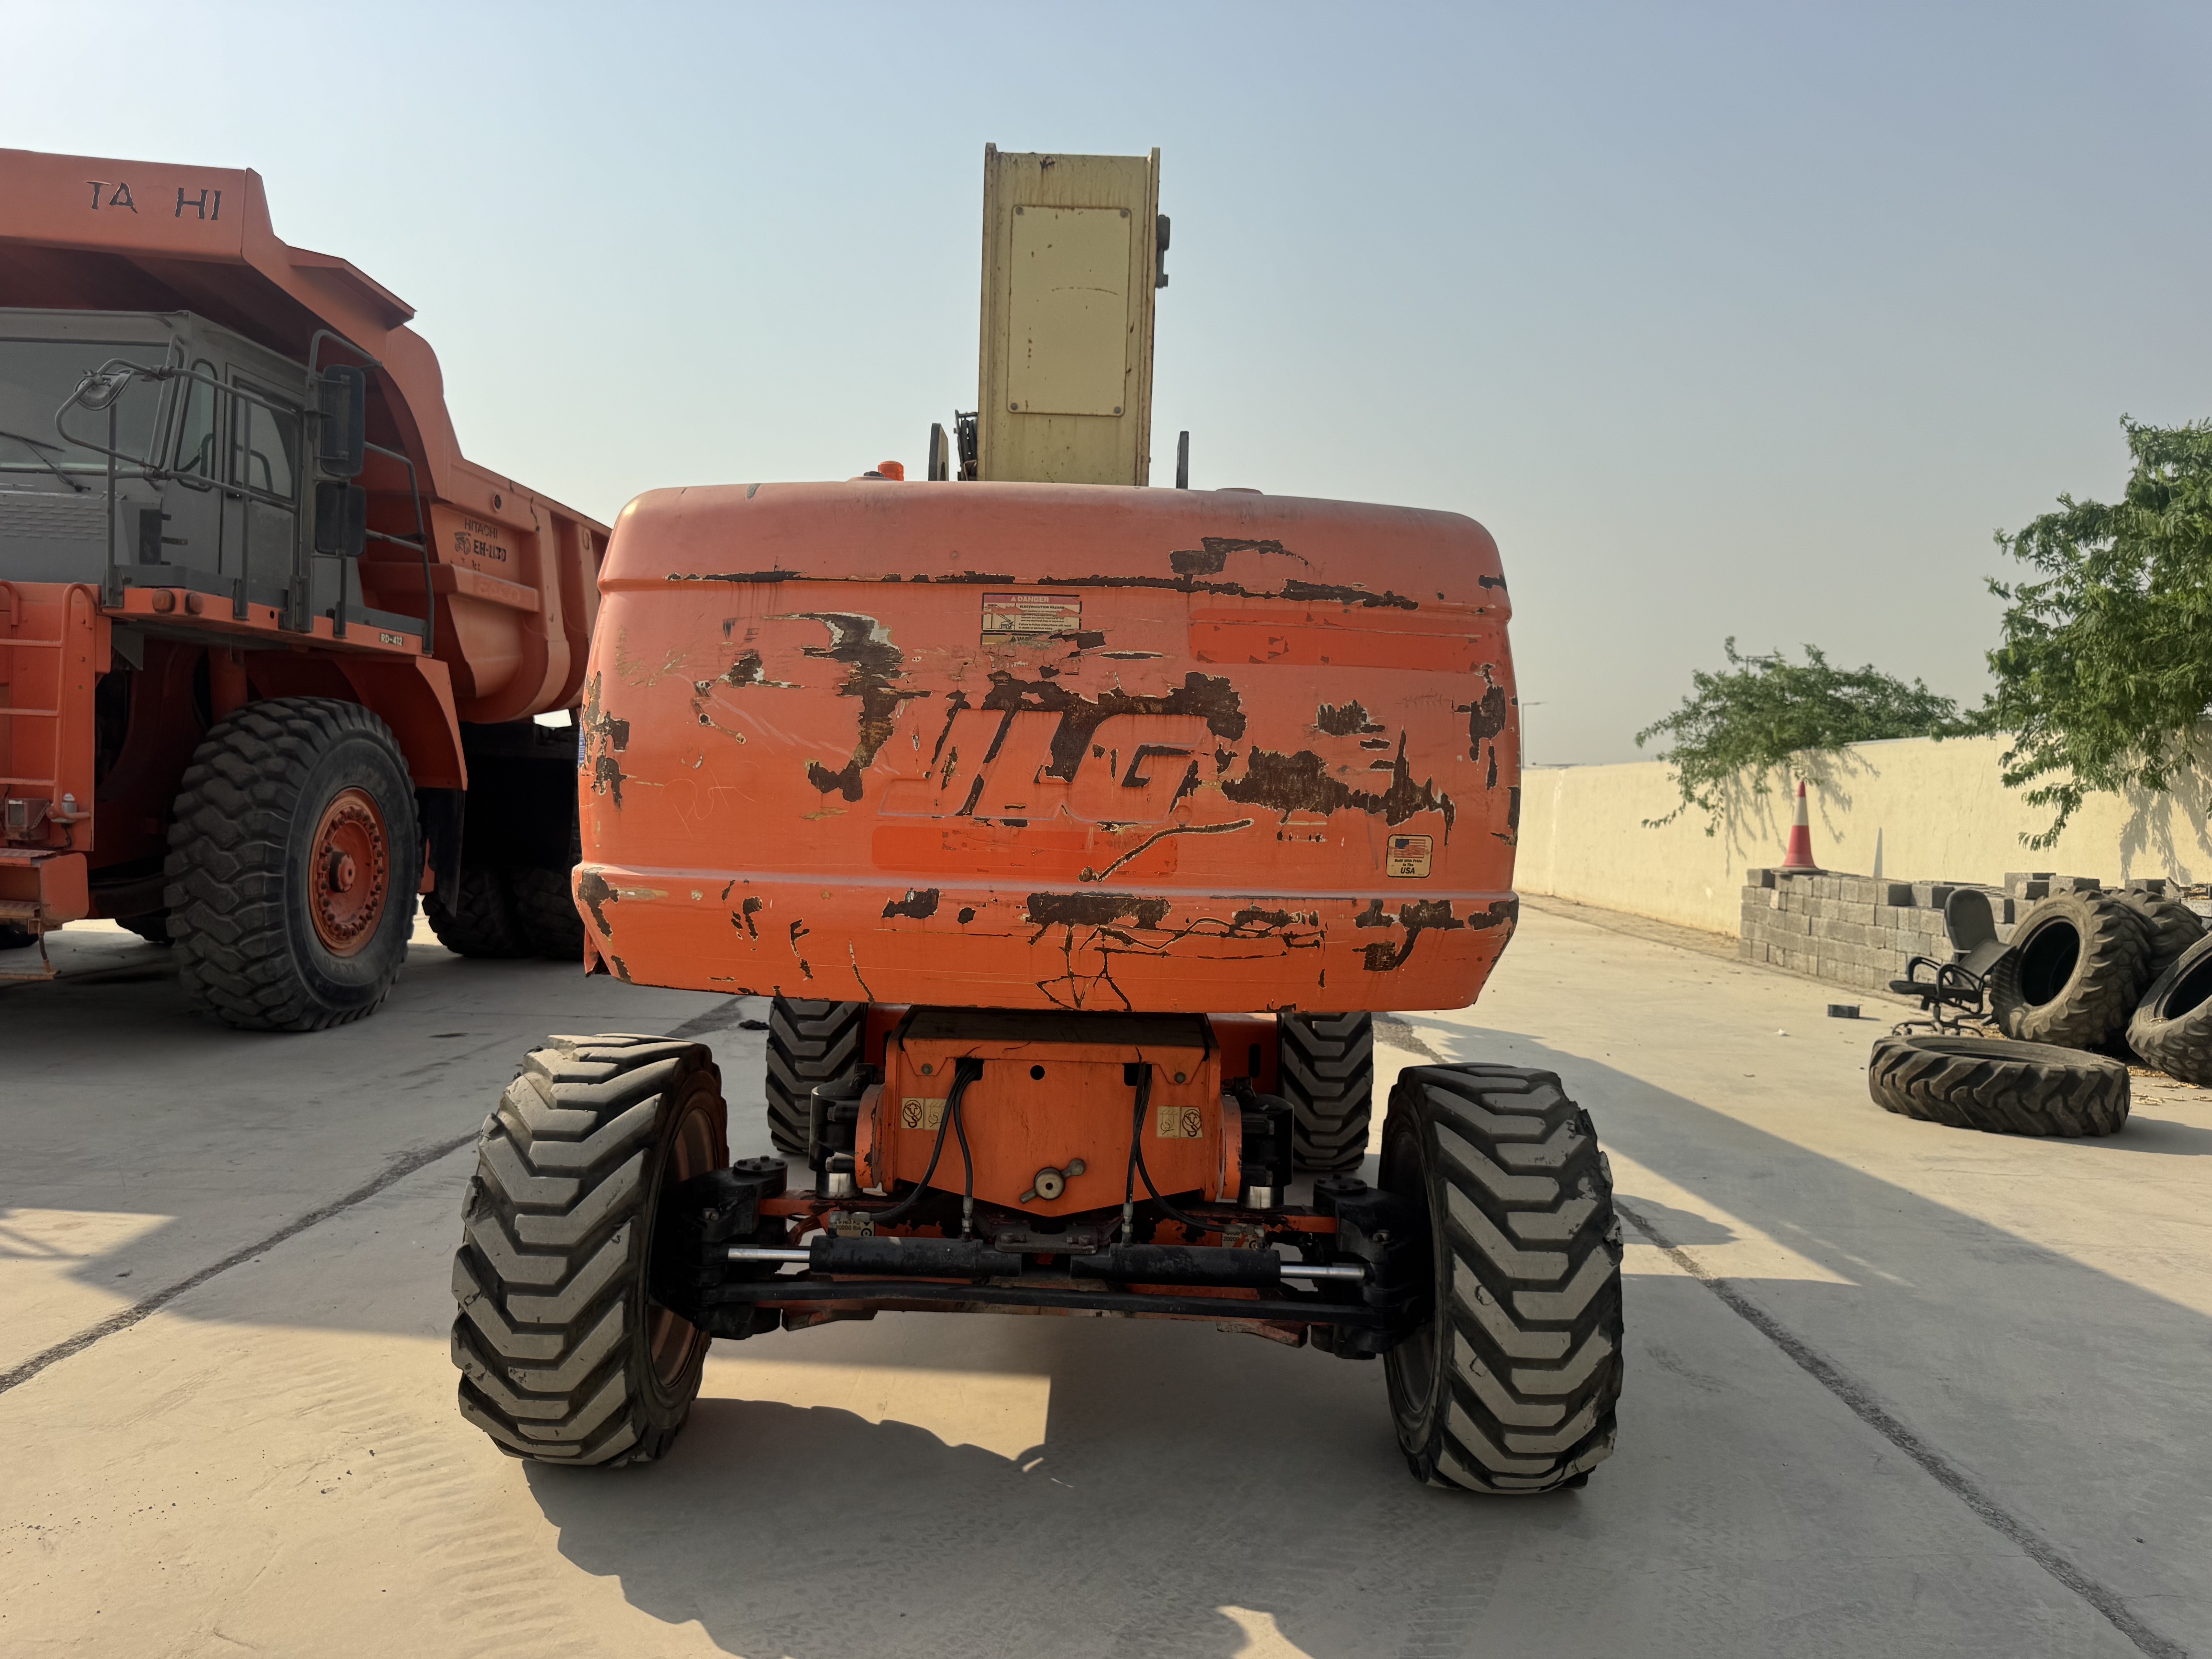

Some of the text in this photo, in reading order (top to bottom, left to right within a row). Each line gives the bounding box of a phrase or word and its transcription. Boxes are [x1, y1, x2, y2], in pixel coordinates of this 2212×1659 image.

[465, 518, 498, 539] HITACHI
[381, 633, 403, 646] RD-412
[877, 708, 1208, 824] JLG
